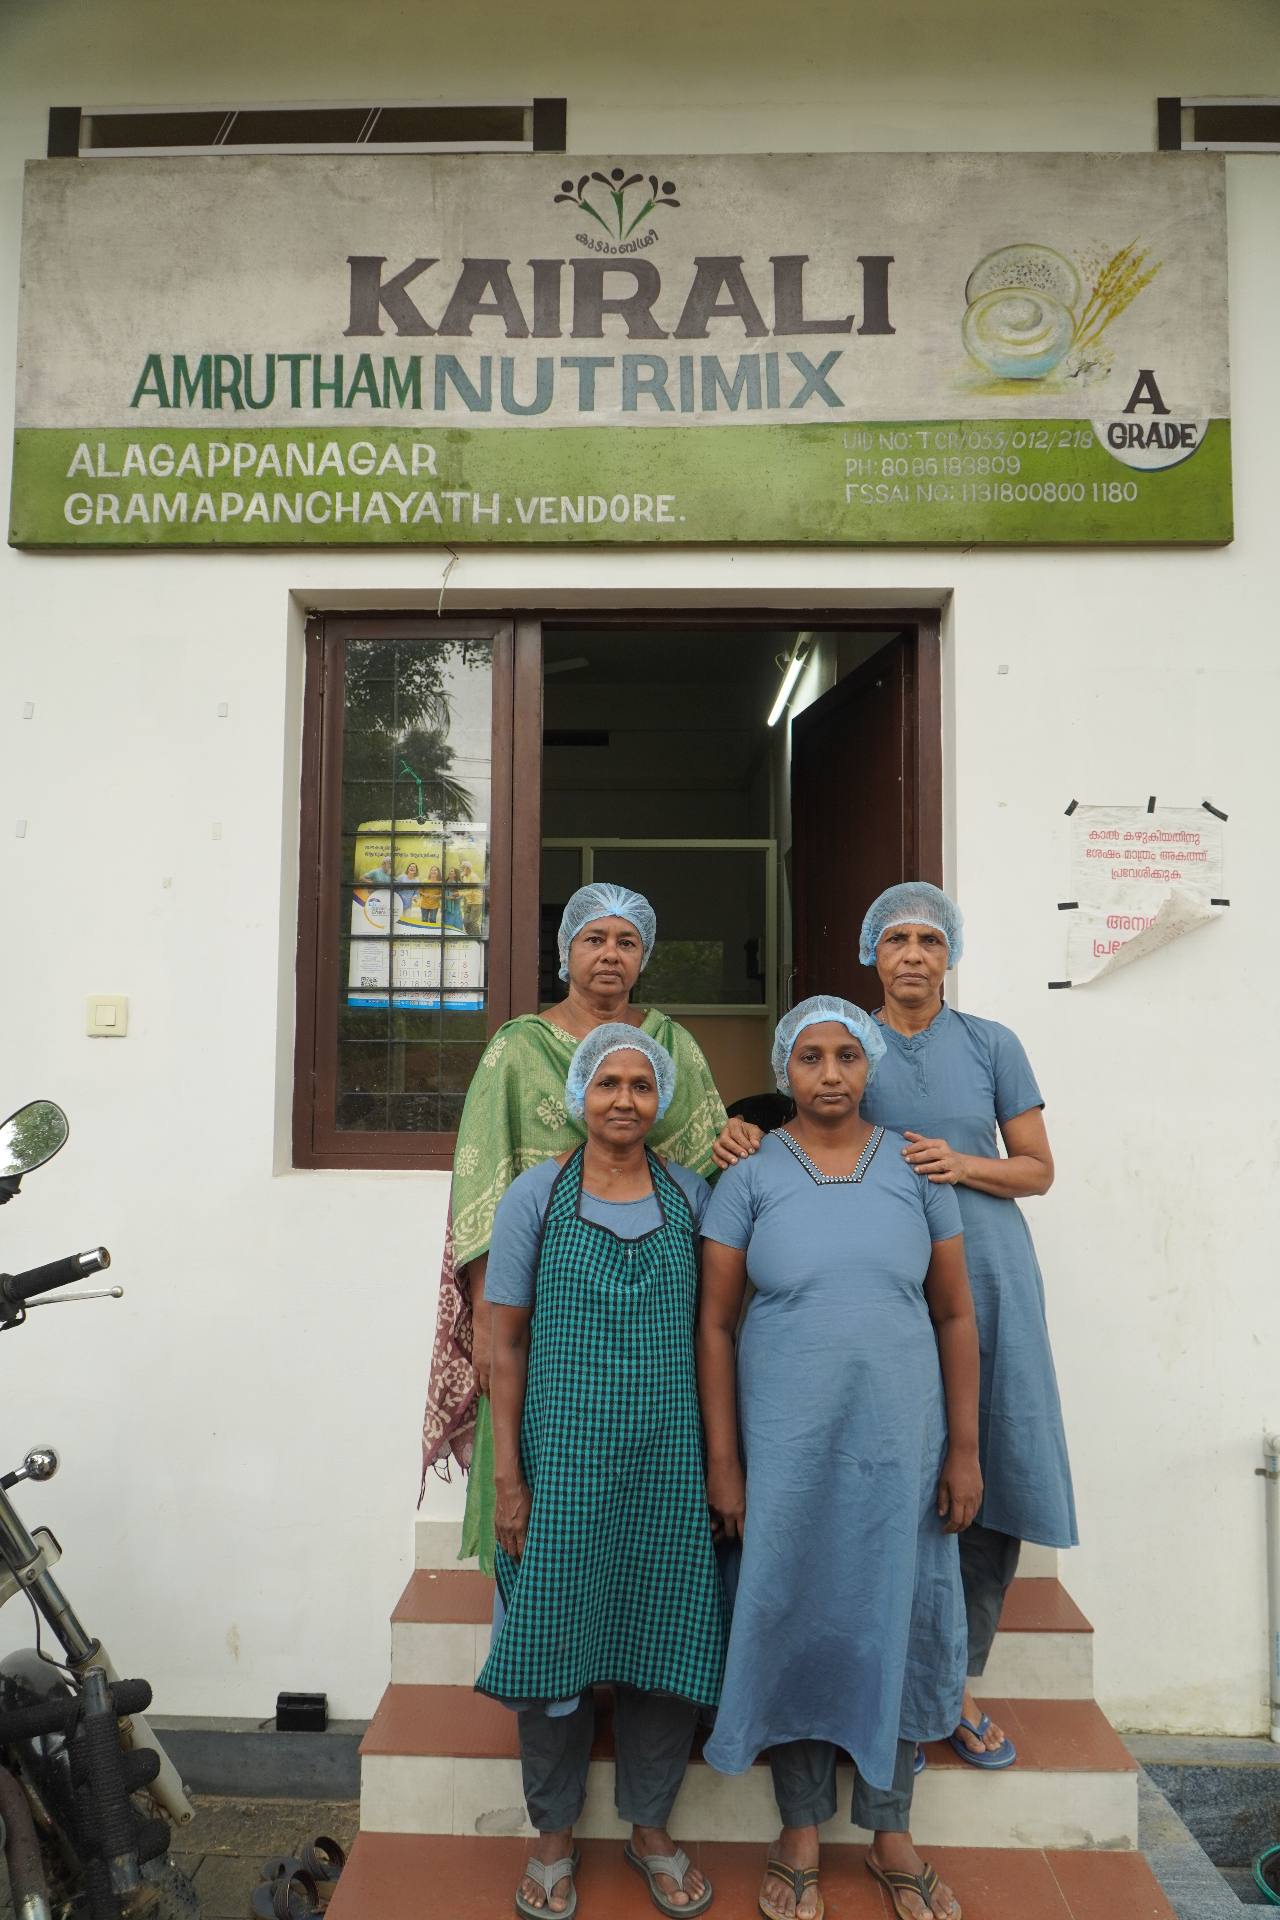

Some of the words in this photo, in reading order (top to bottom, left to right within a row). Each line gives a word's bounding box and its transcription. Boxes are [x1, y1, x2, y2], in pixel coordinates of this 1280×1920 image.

[343, 255, 896, 339] KAIRALI
[130, 353, 424, 412] AMRUTHAM
[434, 350, 846, 416] NUTRIMIX
[1122, 370, 1171, 415] A
[844, 431, 873, 451] UID
[880, 431, 913, 451] NO:
[1107, 422, 1198, 450] GRADE
[66, 441, 438, 478] ALAGAPPANAGAR
[846, 483, 909, 504] FSSAI
[917, 484, 955, 502] NO:
[1089, 830, 1119, 840] കാൽ
[1086, 848, 1121, 859] ശേഷം
[1124, 849, 1156, 862] മാത്രം
[1112, 867, 1181, 881] പ്രവേശിക്കുക
[400, 949, 409, 957] 31
[412, 970, 420, 978] 11
[424, 970, 432, 978] 12
